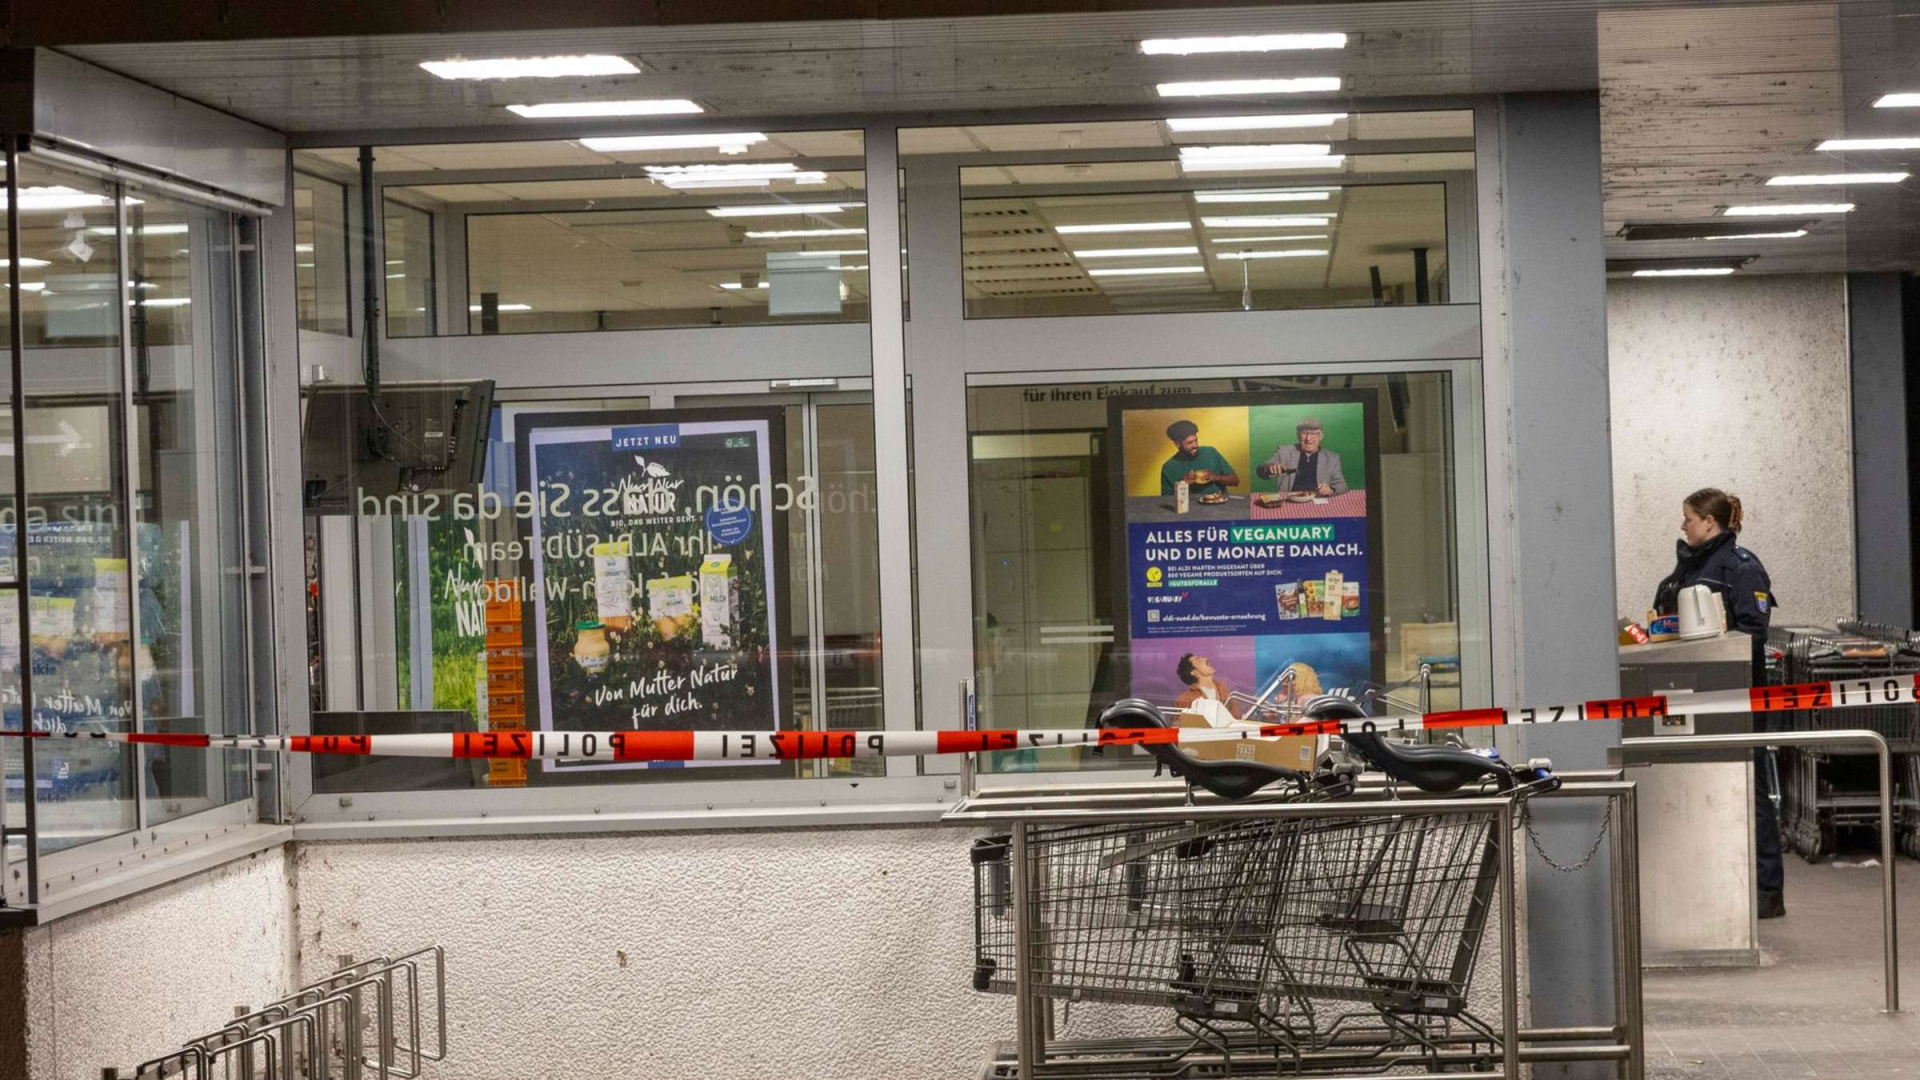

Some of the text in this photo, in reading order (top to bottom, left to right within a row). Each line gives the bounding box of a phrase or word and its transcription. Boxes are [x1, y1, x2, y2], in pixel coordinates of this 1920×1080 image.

[1023, 388, 1046, 402] für
[1051, 388, 1092, 401] Ihren
[616, 435, 677, 447] JETZT NEU
[646, 517, 673, 525] WEITER
[1146, 527, 1332, 544] ALLES FÜR VEGANUARY
[1146, 544, 1363, 561] UND DIE MONATE DANACH.
[595, 663, 738, 706] Von Mutter Natur
[632, 692, 702, 730] für dich.
